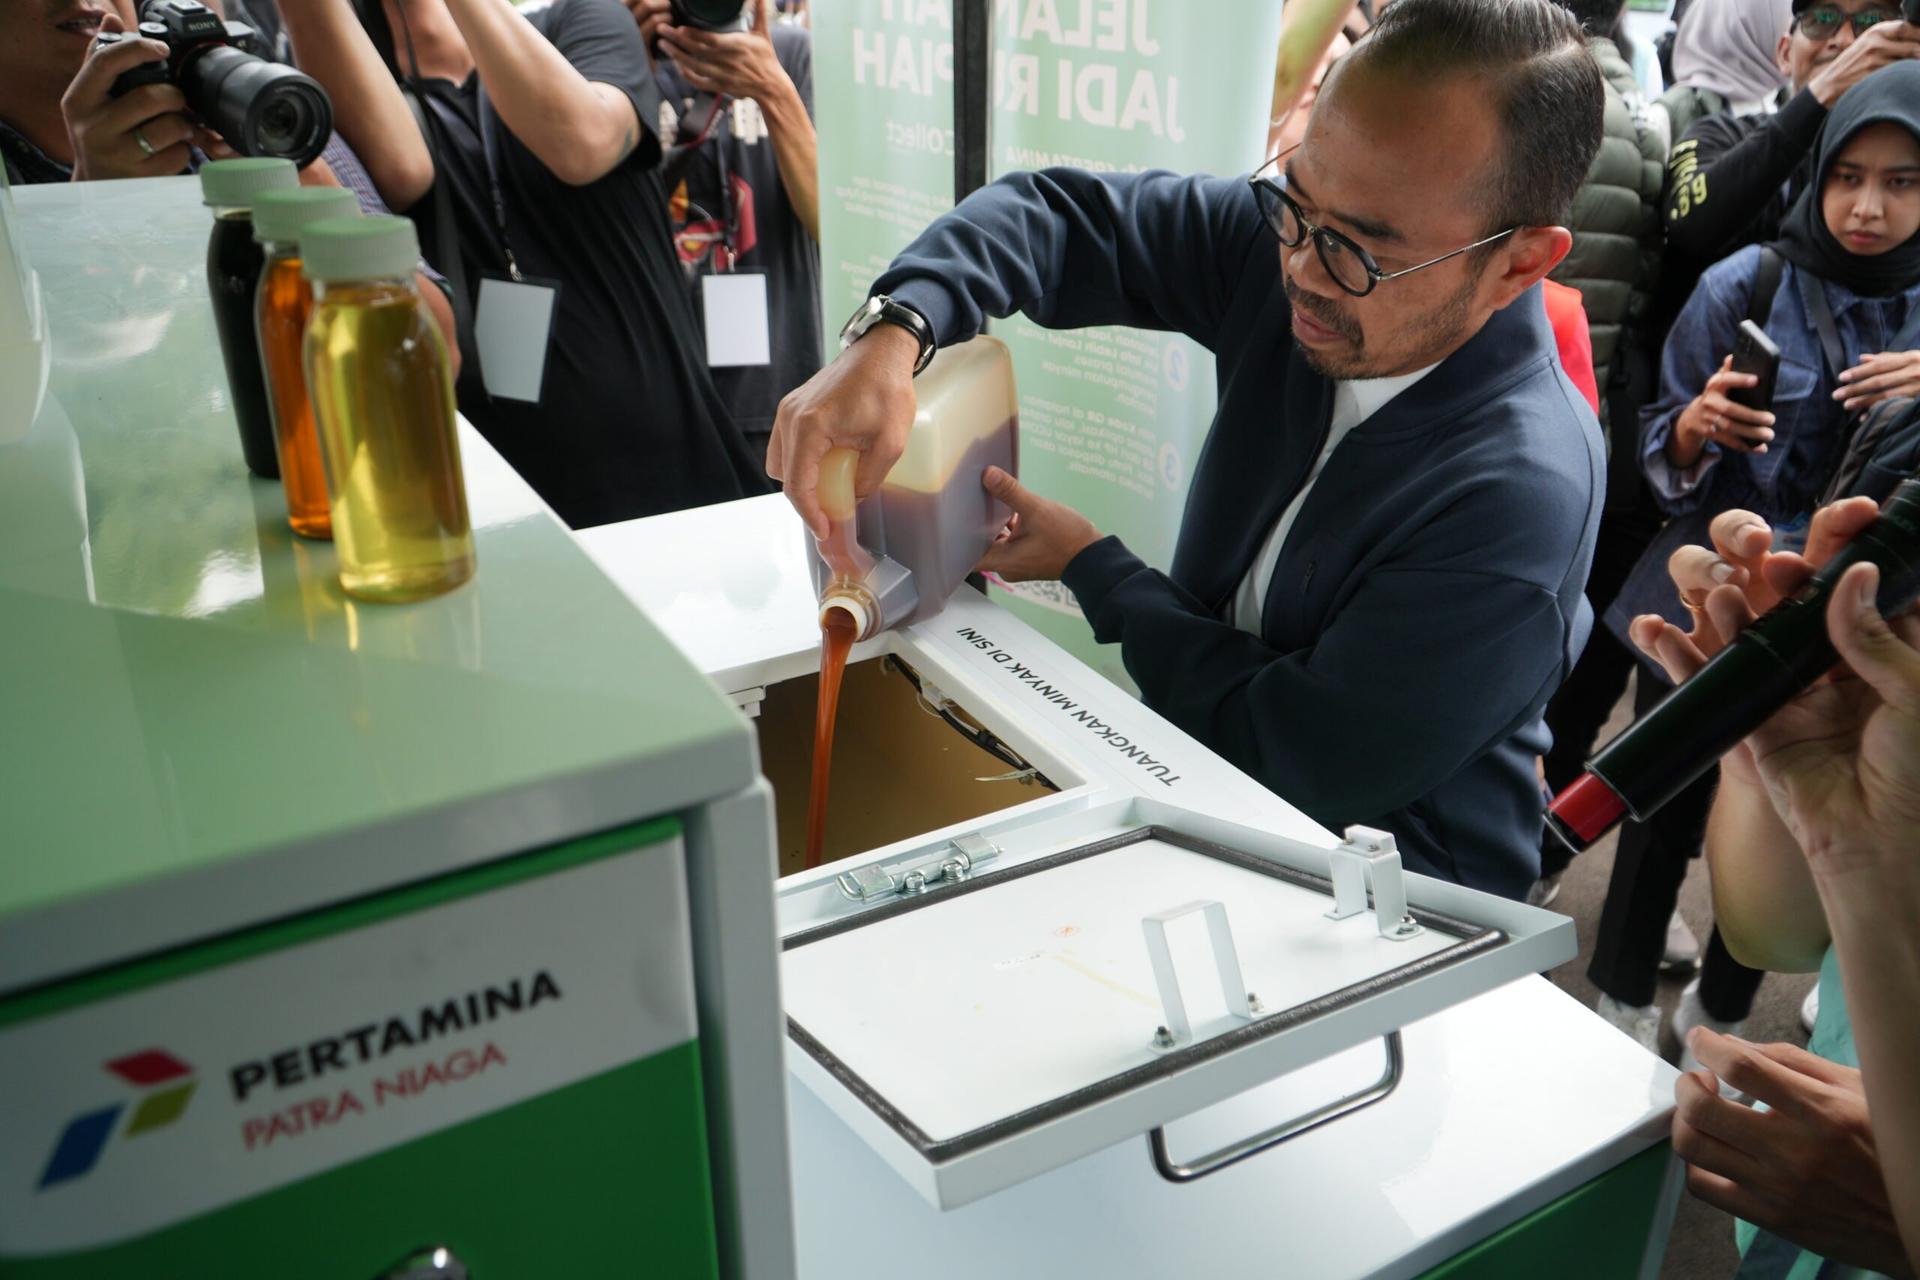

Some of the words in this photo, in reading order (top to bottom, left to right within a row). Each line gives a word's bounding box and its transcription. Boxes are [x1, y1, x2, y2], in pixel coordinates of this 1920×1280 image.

[956, 627, 994, 650] SINI
[986, 649, 1013, 664] DI
[1003, 662, 1078, 711] MINYAK
[1071, 709, 1182, 787] TUANGKAN
[228, 970, 562, 1106] PERTAMINA
[242, 1089, 364, 1152] PATRA
[373, 1041, 507, 1106] NIAGA
